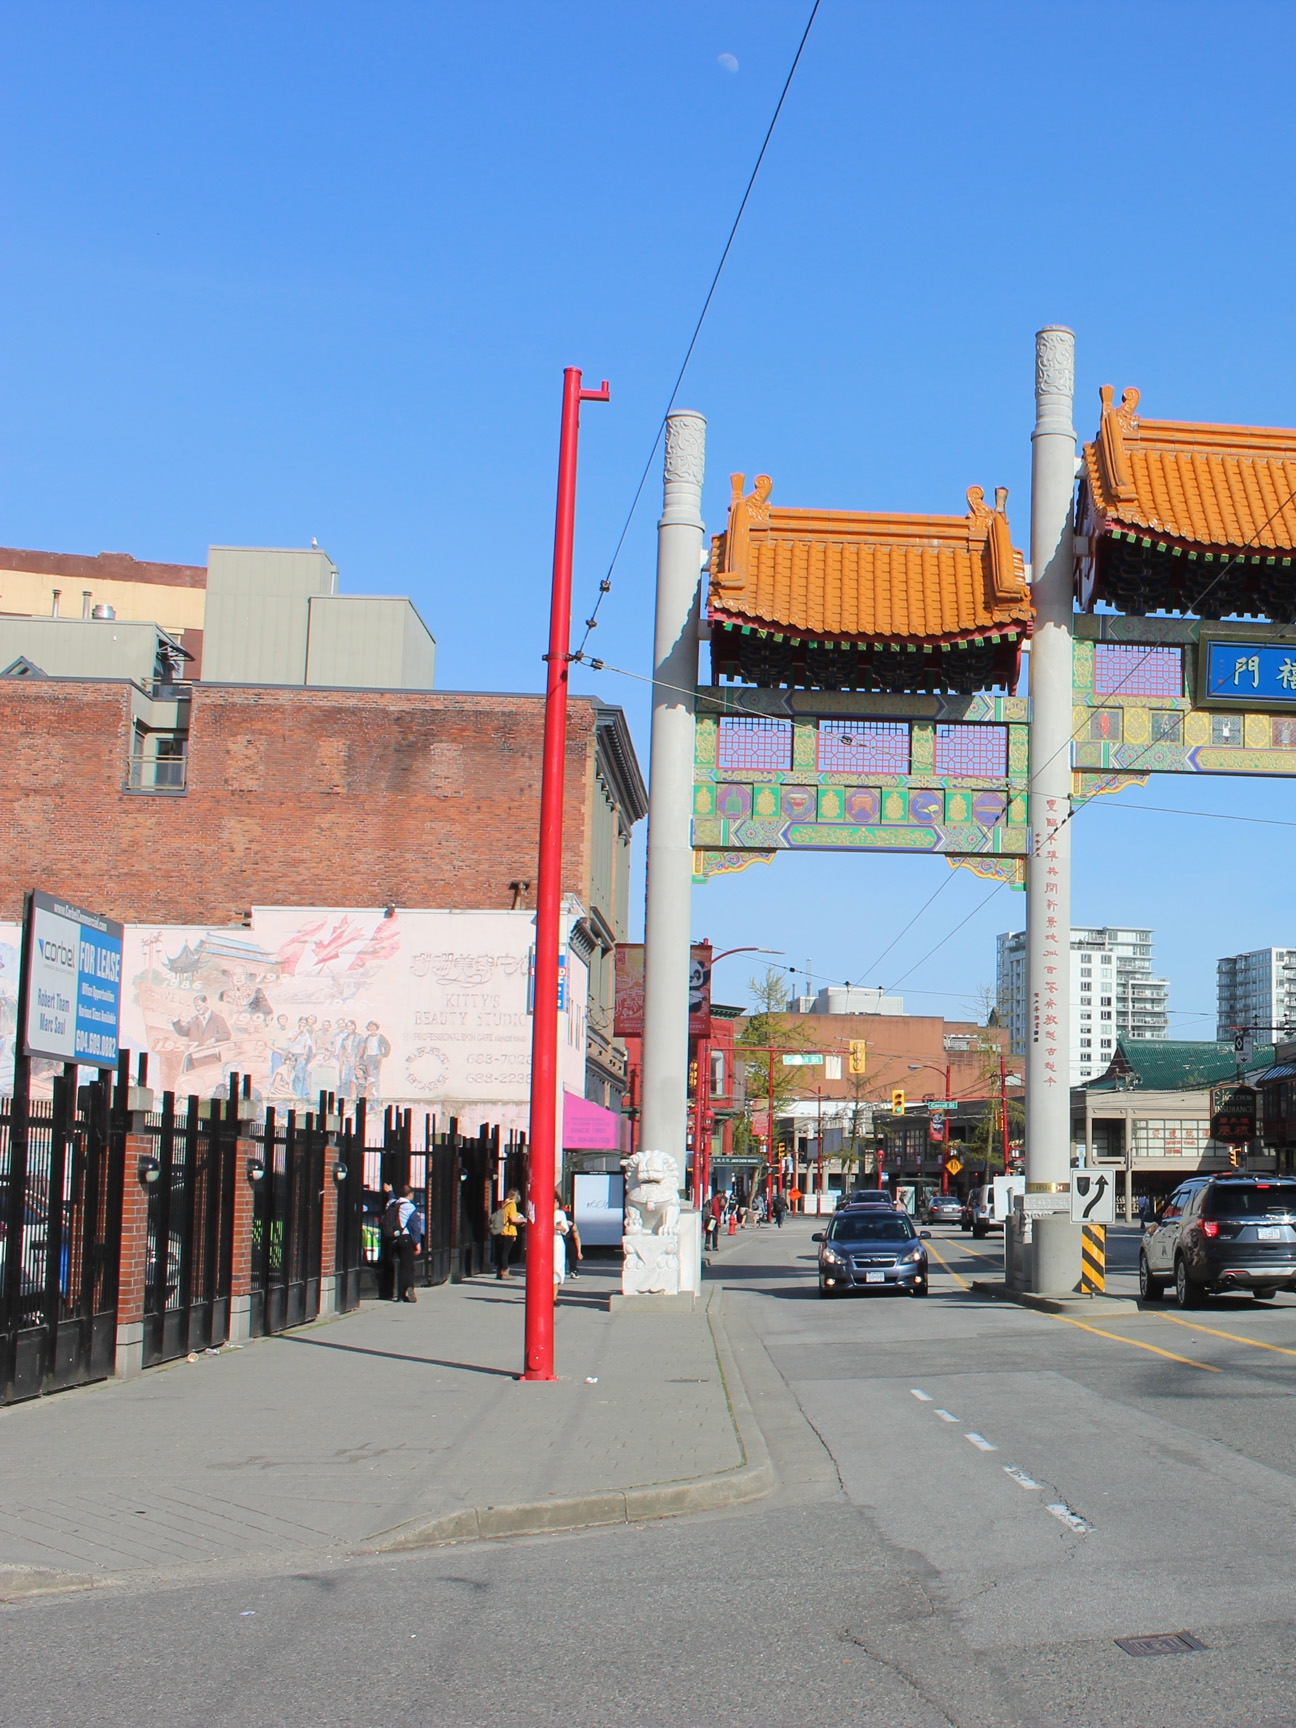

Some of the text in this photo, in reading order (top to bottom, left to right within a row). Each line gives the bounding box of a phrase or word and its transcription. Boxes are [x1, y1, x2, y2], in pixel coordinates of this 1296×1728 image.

[44, 940, 75, 968] corbel
[80, 940, 120, 982] FOR LEASE
[38, 988, 56, 1009] Robert
[445, 994, 501, 1008] KITTY'S
[40, 1012, 54, 1033] Marc
[414, 1011, 529, 1026] BEAUTY STUDIO
[413, 1032, 460, 1042] PROFESSIONAL
[1215, 1105, 1254, 1113] INSURANCE
